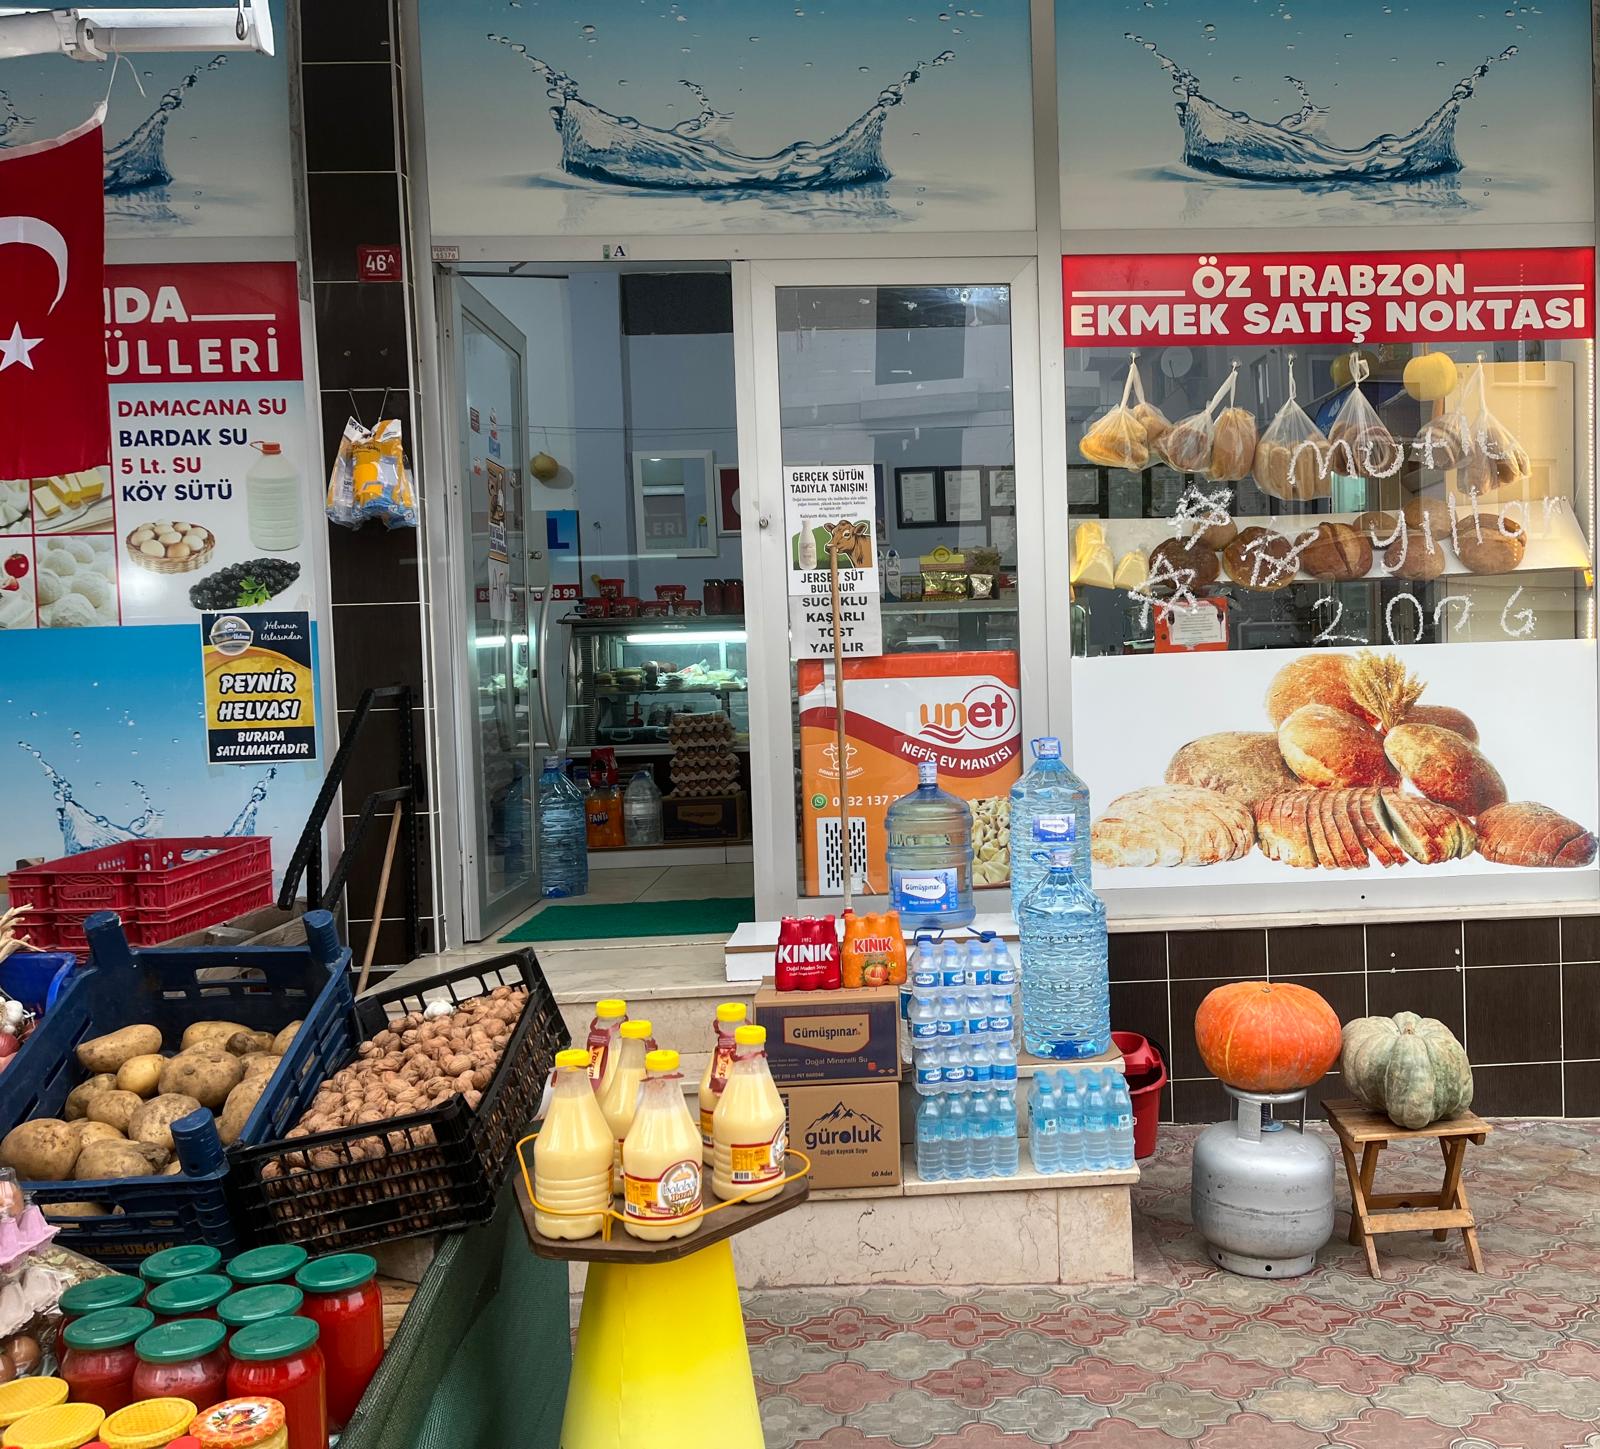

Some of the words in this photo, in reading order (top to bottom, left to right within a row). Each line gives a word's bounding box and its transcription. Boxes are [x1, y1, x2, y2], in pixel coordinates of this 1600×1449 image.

[614, 245, 626, 257] A
[1192, 255, 1252, 299] ÖZ
[1263, 263, 1465, 298] TRABZON
[103, 286, 189, 324] DA
[1070, 303, 1230, 336] EKMEK
[1242, 301, 1372, 344] SATIŞ
[1385, 297, 1585, 333] NOKTASI
[117, 398, 252, 418] DAMACANA
[258, 398, 287, 416] SU
[119, 429, 213, 447] BARDAK
[218, 428, 248, 446] SU
[120, 458, 134, 474] 5
[140, 457, 166, 474] Lt.
[172, 457, 202, 474] SU
[792, 471, 830, 483] GERÇEK
[832, 468, 865, 481] SÜTÜN
[121, 480, 167, 502] KÖY
[174, 478, 233, 501] SÜTÜ
[790, 483, 828, 493] TADIYLA
[829, 482, 868, 494] TANIŞIN!
[800, 572, 840, 583] JERSE
[844, 569, 865, 581] SÜT
[802, 596, 868, 607] SUCKLU
[219, 668, 296, 694] PEYNİR
[218, 699, 300, 721] HELVASI
[920, 693, 1008, 729] unet
[237, 731, 285, 743] BURADA
[216, 743, 309, 757] SATILMAKTADIR
[901, 742, 938, 763] NEFİS
[940, 756, 958, 769] EV
[960, 745, 1013, 770] MANTISI
[832, 796, 863, 807] 032
[867, 795, 889, 806] 137
[778, 944, 834, 964] KINIK
[792, 1027, 858, 1040] Gümüşpınar
[805, 1058, 825, 1066] Doğal
[826, 1056, 857, 1065] Mineralli
